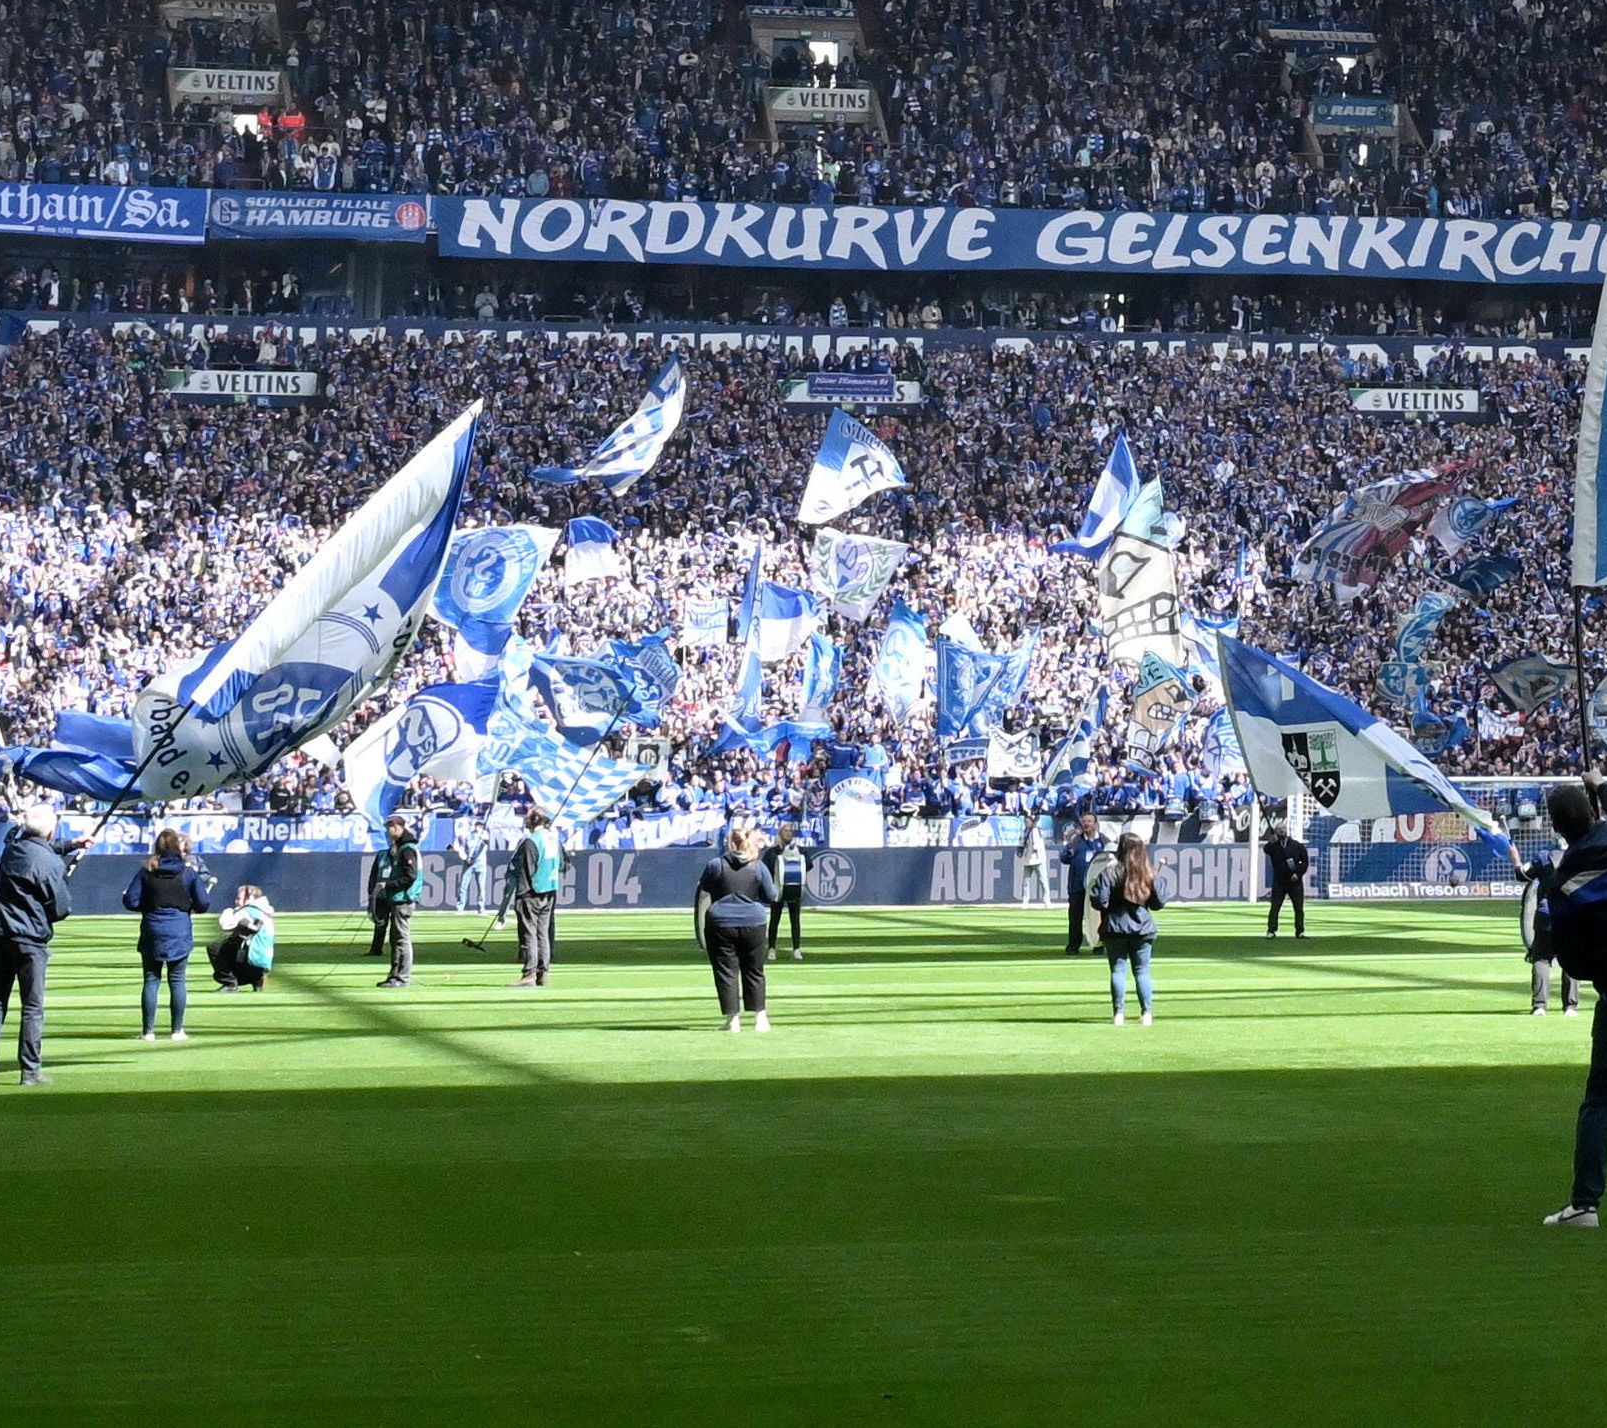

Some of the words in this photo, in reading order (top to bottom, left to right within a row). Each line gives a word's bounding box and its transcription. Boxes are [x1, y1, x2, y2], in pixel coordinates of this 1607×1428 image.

[205, 73, 276, 92] VELTINS
[799, 91, 867, 109] VELTINS
[246, 197, 328, 210] SCHALKER
[332, 198, 391, 211] FILIALE
[246, 209, 390, 229] HAMBURG
[459, 195, 997, 270] NORDKURVE
[216, 373, 301, 394] VELTINS
[1387, 392, 1465, 410] VELTINS
[243, 815, 369, 845] Rheinberg
[587, 852, 643, 905] 04
[930, 850, 1003, 901] AUF
